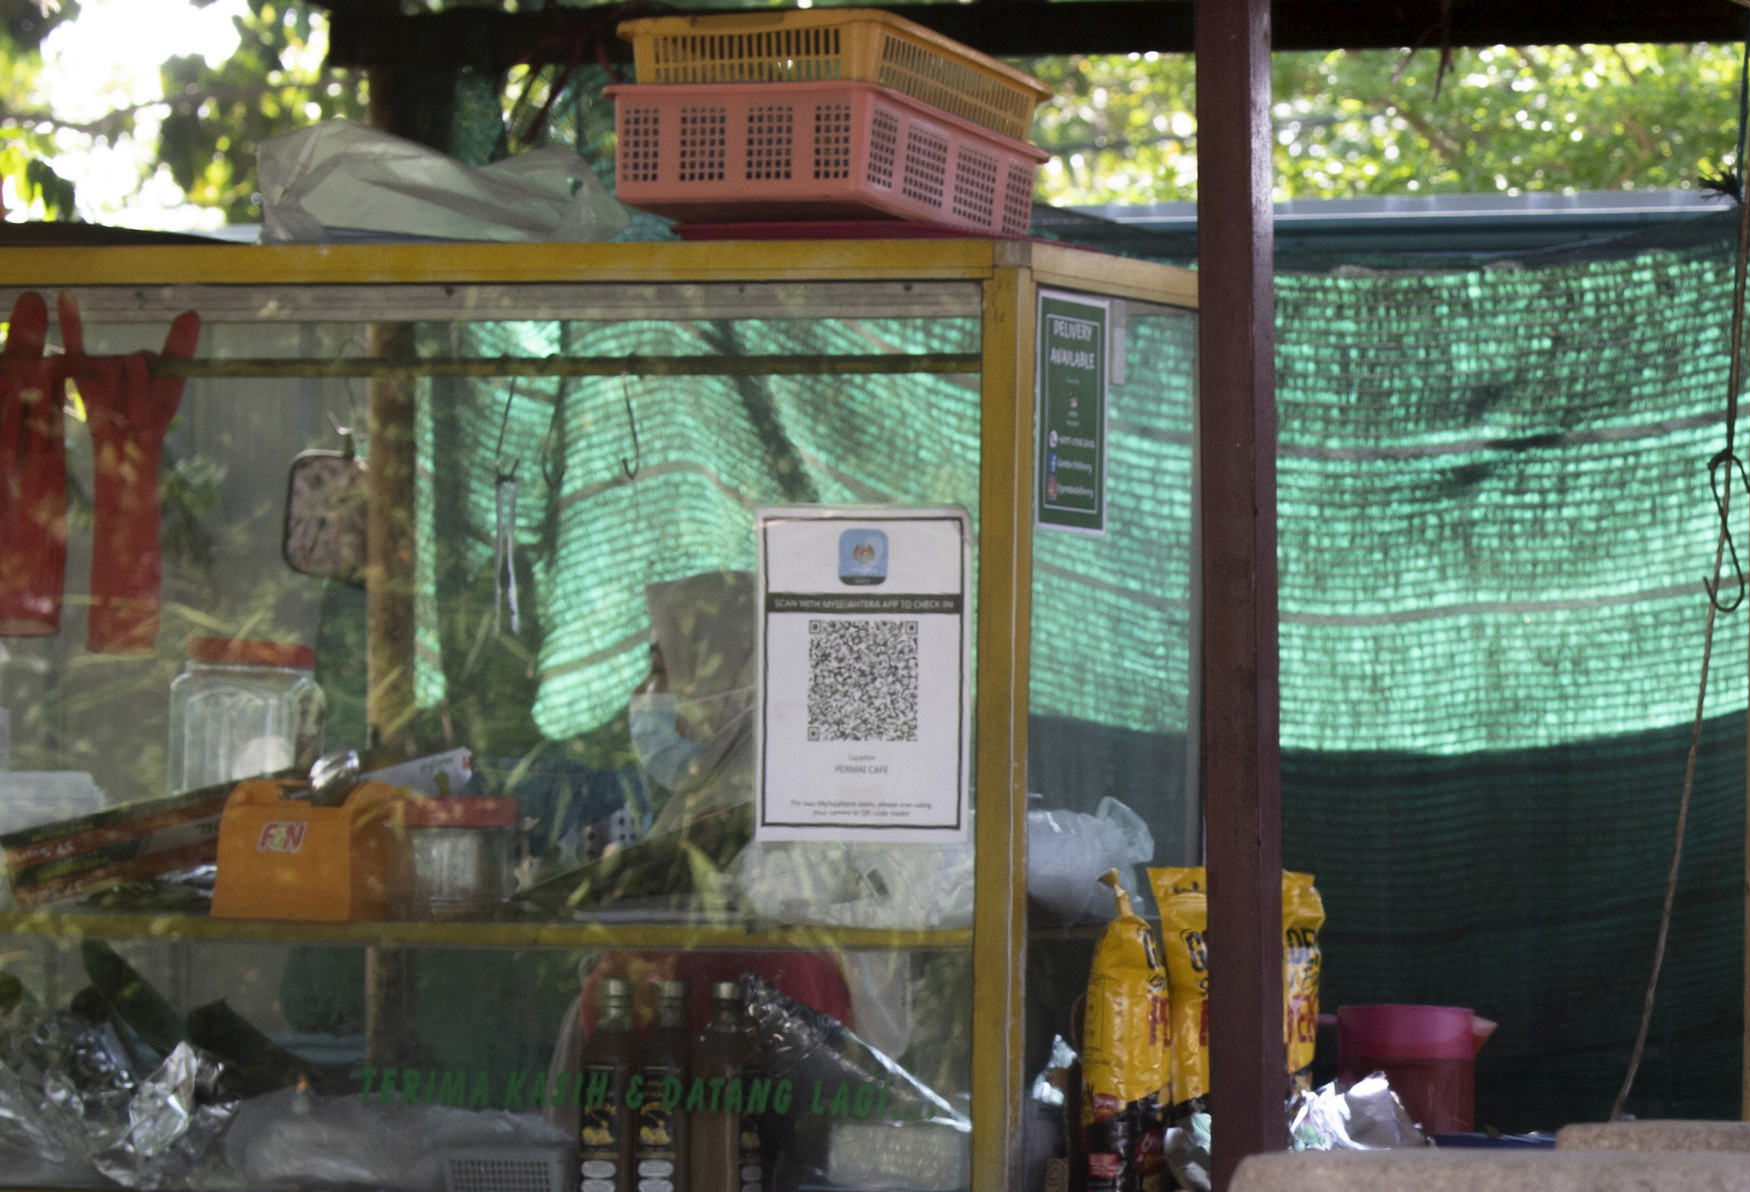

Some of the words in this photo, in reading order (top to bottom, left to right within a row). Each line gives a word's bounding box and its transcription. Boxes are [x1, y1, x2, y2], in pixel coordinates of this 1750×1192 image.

[1053, 319, 1092, 341] DELIVERY
[1050, 347, 1095, 370] AVAILABLE
[774, 599, 798, 608] SCAN
[800, 599, 821, 608] WITH
[882, 600, 898, 608] APP
[901, 600, 911, 609] TO
[256, 820, 308, 853] F&N
[360, 1067, 489, 1111] TERIMA
[505, 1071, 608, 1109] KASIH
[625, 1075, 645, 1110] &
[662, 1077, 794, 1115] DATANG
